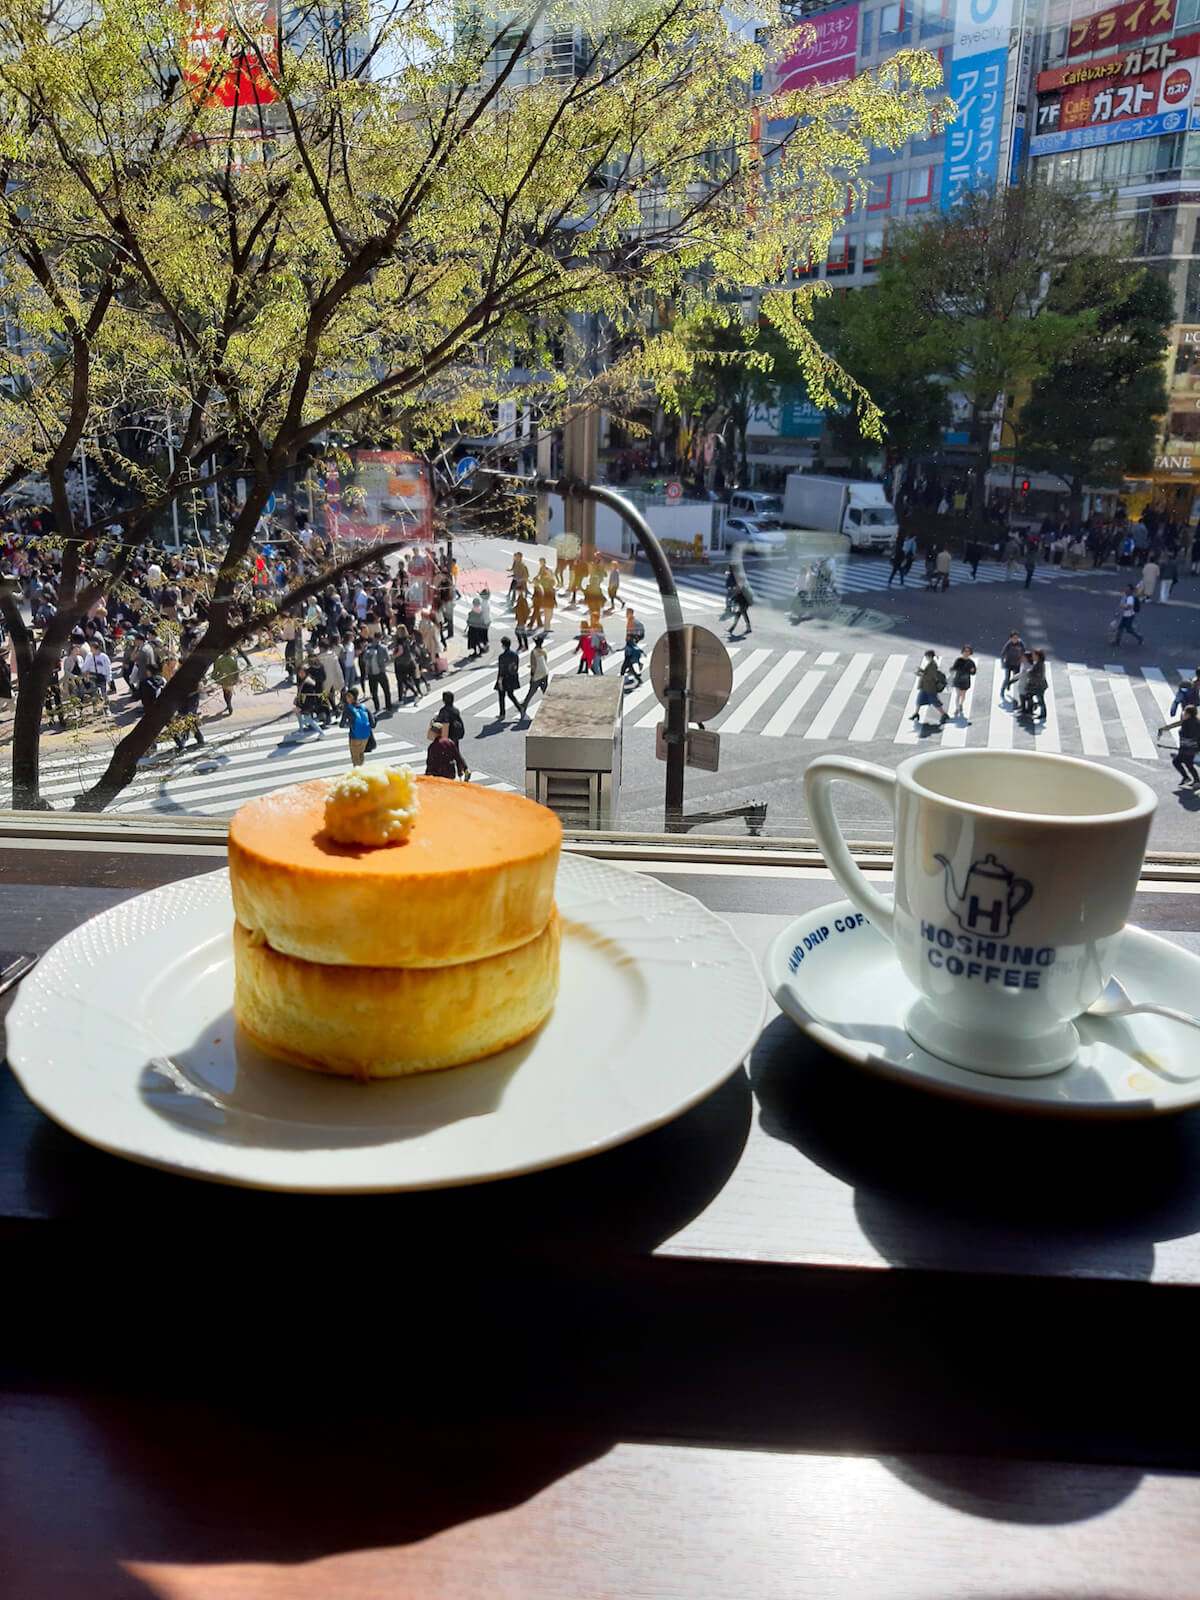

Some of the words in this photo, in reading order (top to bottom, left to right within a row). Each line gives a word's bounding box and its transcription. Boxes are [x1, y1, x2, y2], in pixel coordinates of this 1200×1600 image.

[960, 25, 1003, 48] eyecity
[1123, 43, 1177, 76] ガスト
[1091, 83, 1153, 122] ガスト
[1166, 83, 1188, 95] ガスト
[1039, 102, 1061, 125] 7F
[803, 925, 830, 952] DRIP
[834, 912, 871, 933] COF
[966, 895, 1003, 933] H
[921, 919, 1056, 967] HOSHINO
[928, 948, 1041, 989] COFFEE
